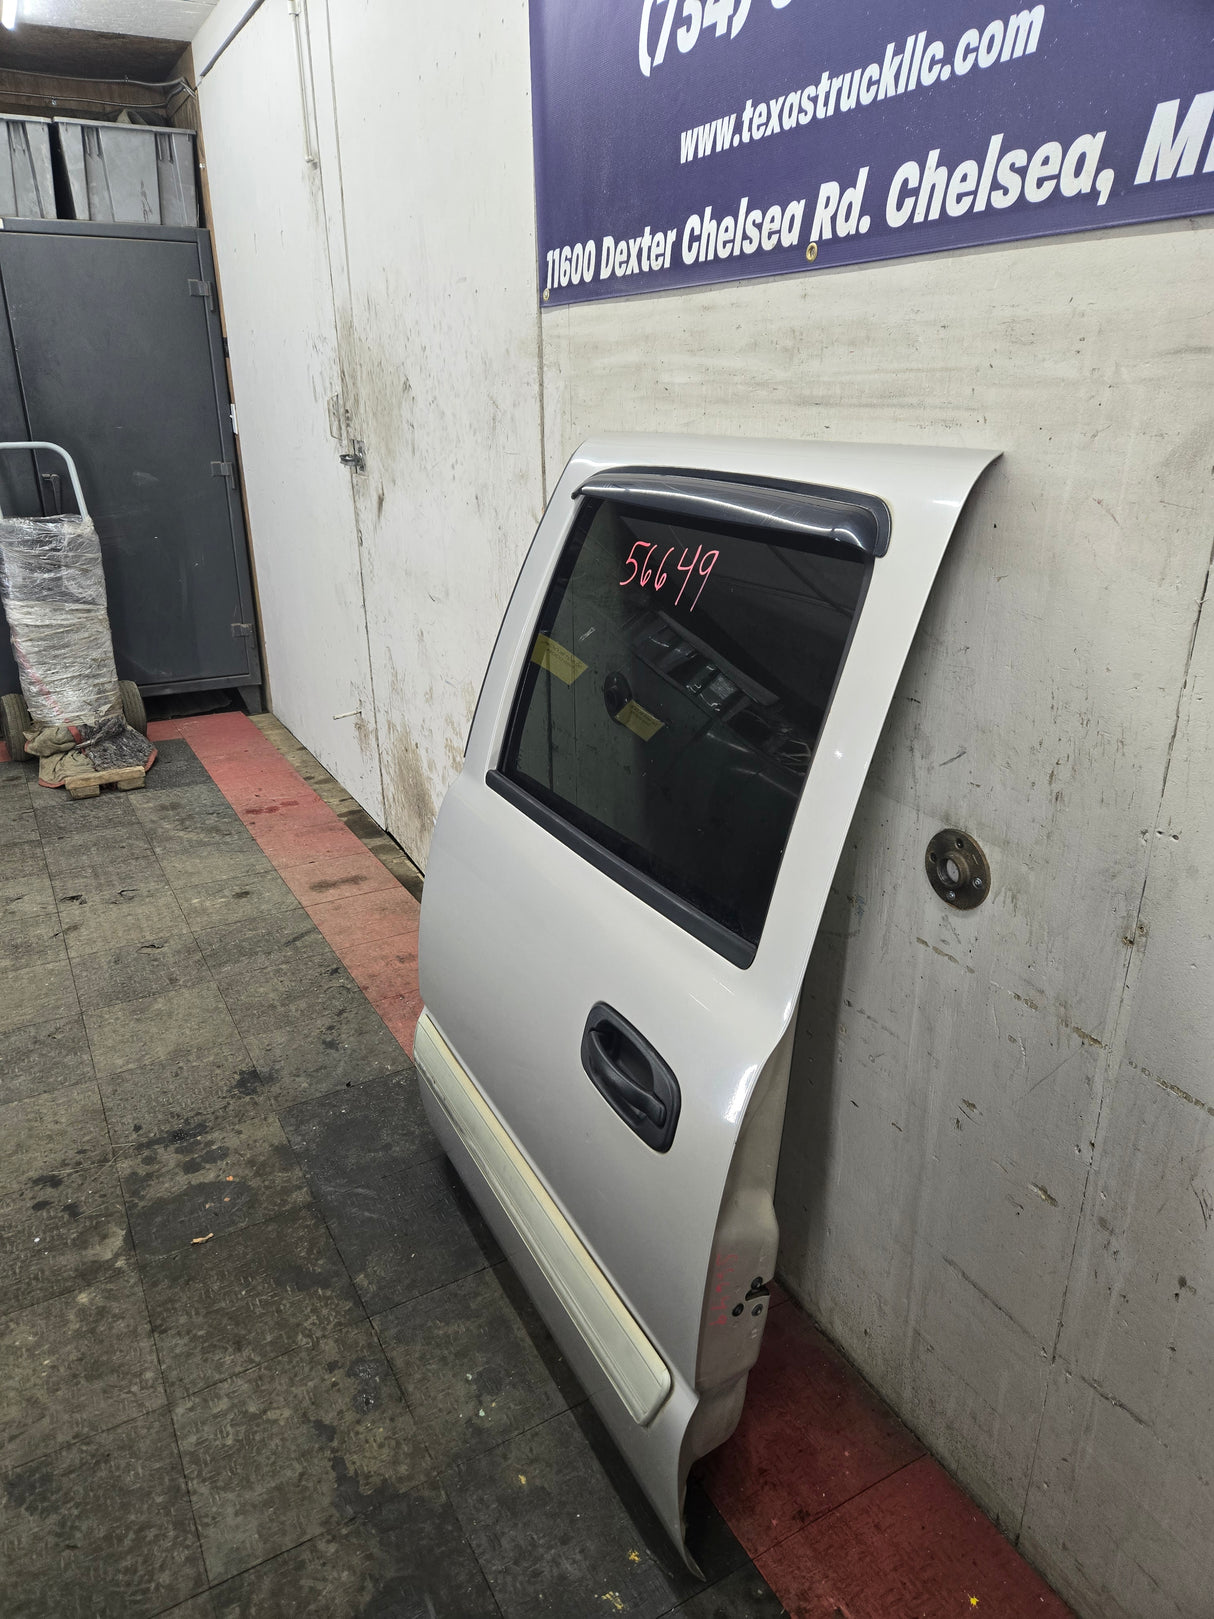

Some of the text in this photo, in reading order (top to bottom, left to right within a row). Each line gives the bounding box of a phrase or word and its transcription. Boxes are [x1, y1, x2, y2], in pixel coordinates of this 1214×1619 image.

[681, 4, 1046, 165] www.texastruckllc.com
[546, 90, 1214, 290] 11600 Dexter Chelsea Rd. Chelsea, M
[619, 541, 720, 612] 56649
